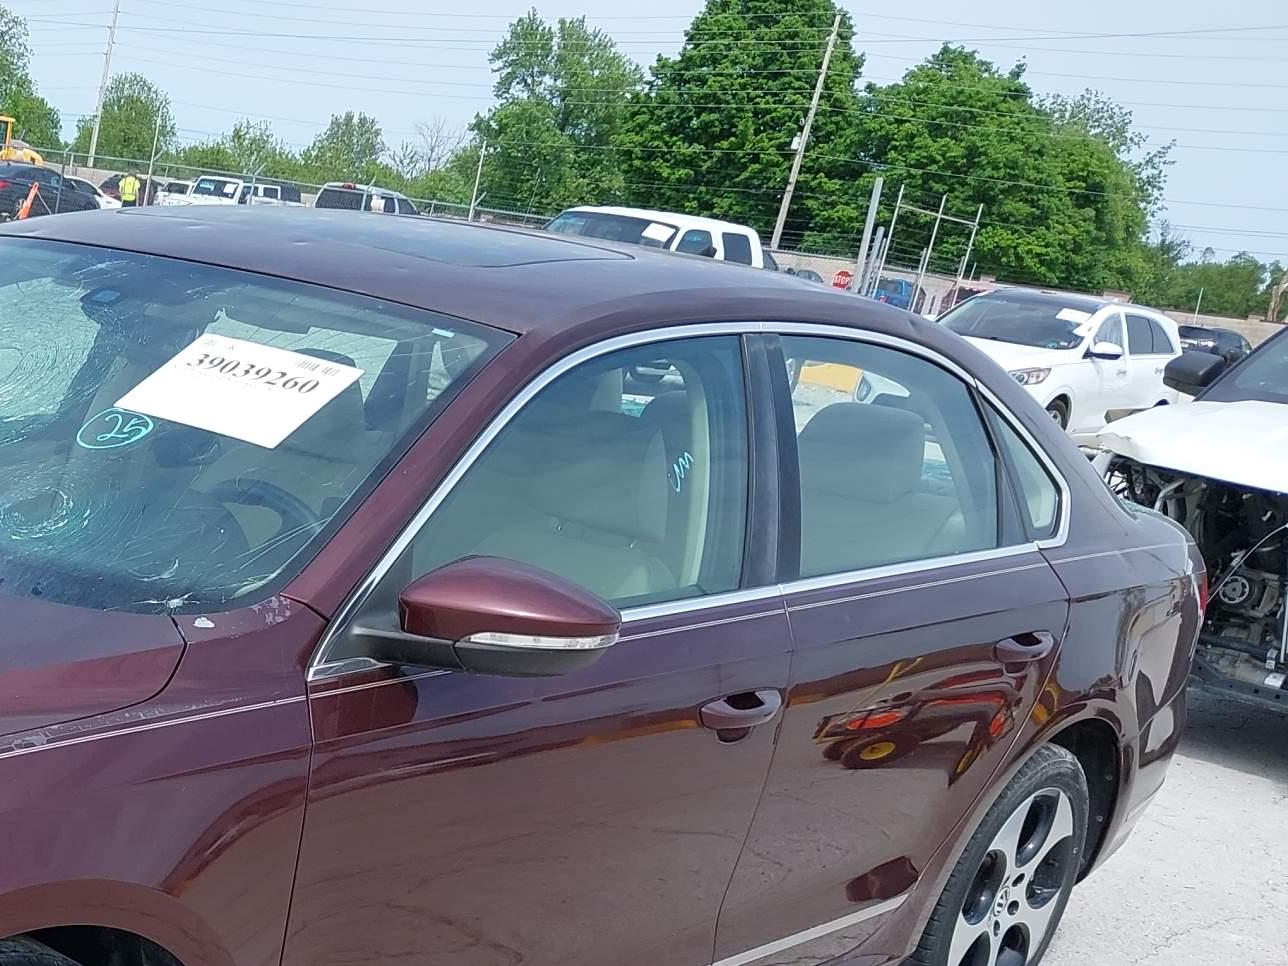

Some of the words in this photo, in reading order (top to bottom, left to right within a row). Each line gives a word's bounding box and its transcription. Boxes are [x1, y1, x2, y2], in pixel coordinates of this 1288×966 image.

[833, 275, 850, 285] STOP
[186, 352, 320, 394] 39039260
[96, 413, 147, 441] 25
